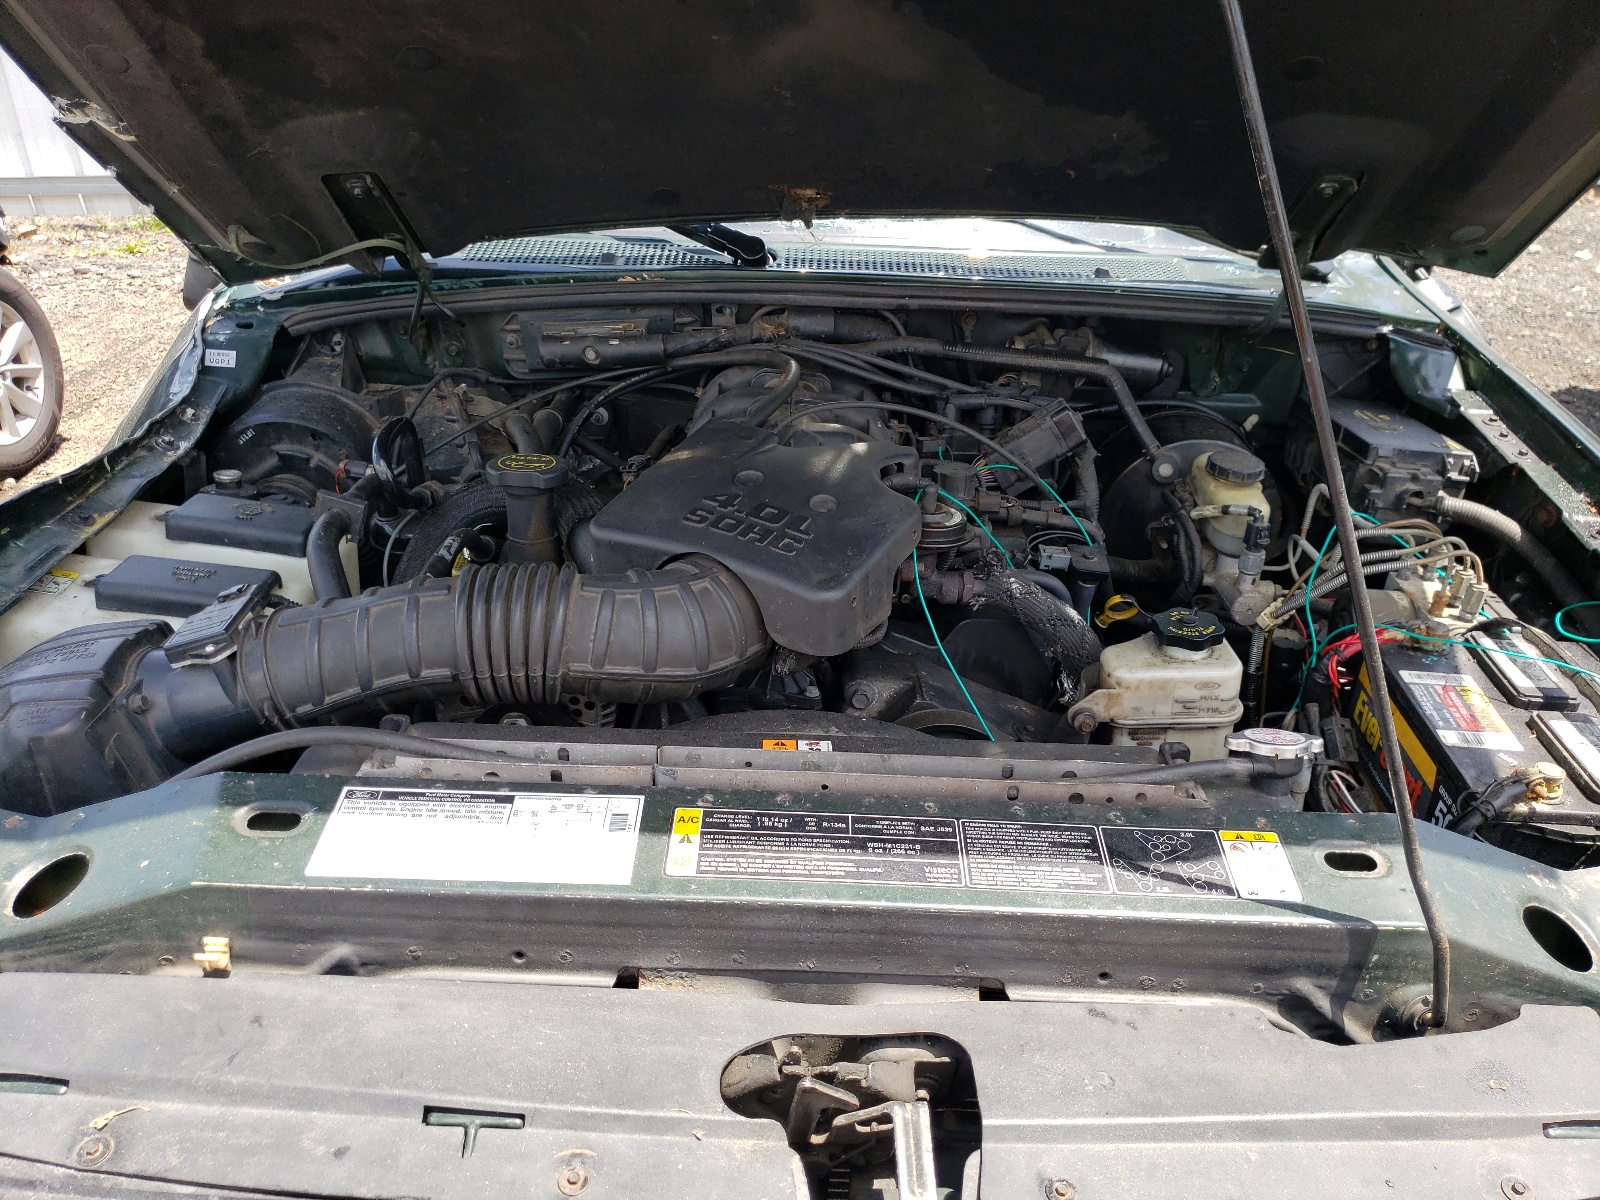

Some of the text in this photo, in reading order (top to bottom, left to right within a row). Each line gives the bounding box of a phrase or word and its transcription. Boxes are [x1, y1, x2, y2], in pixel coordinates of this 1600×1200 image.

[702, 492, 813, 539] 4.0L
[682, 507, 806, 556] SOHC
[678, 816, 700, 824] A/C
[923, 865, 957, 874] Visteon
